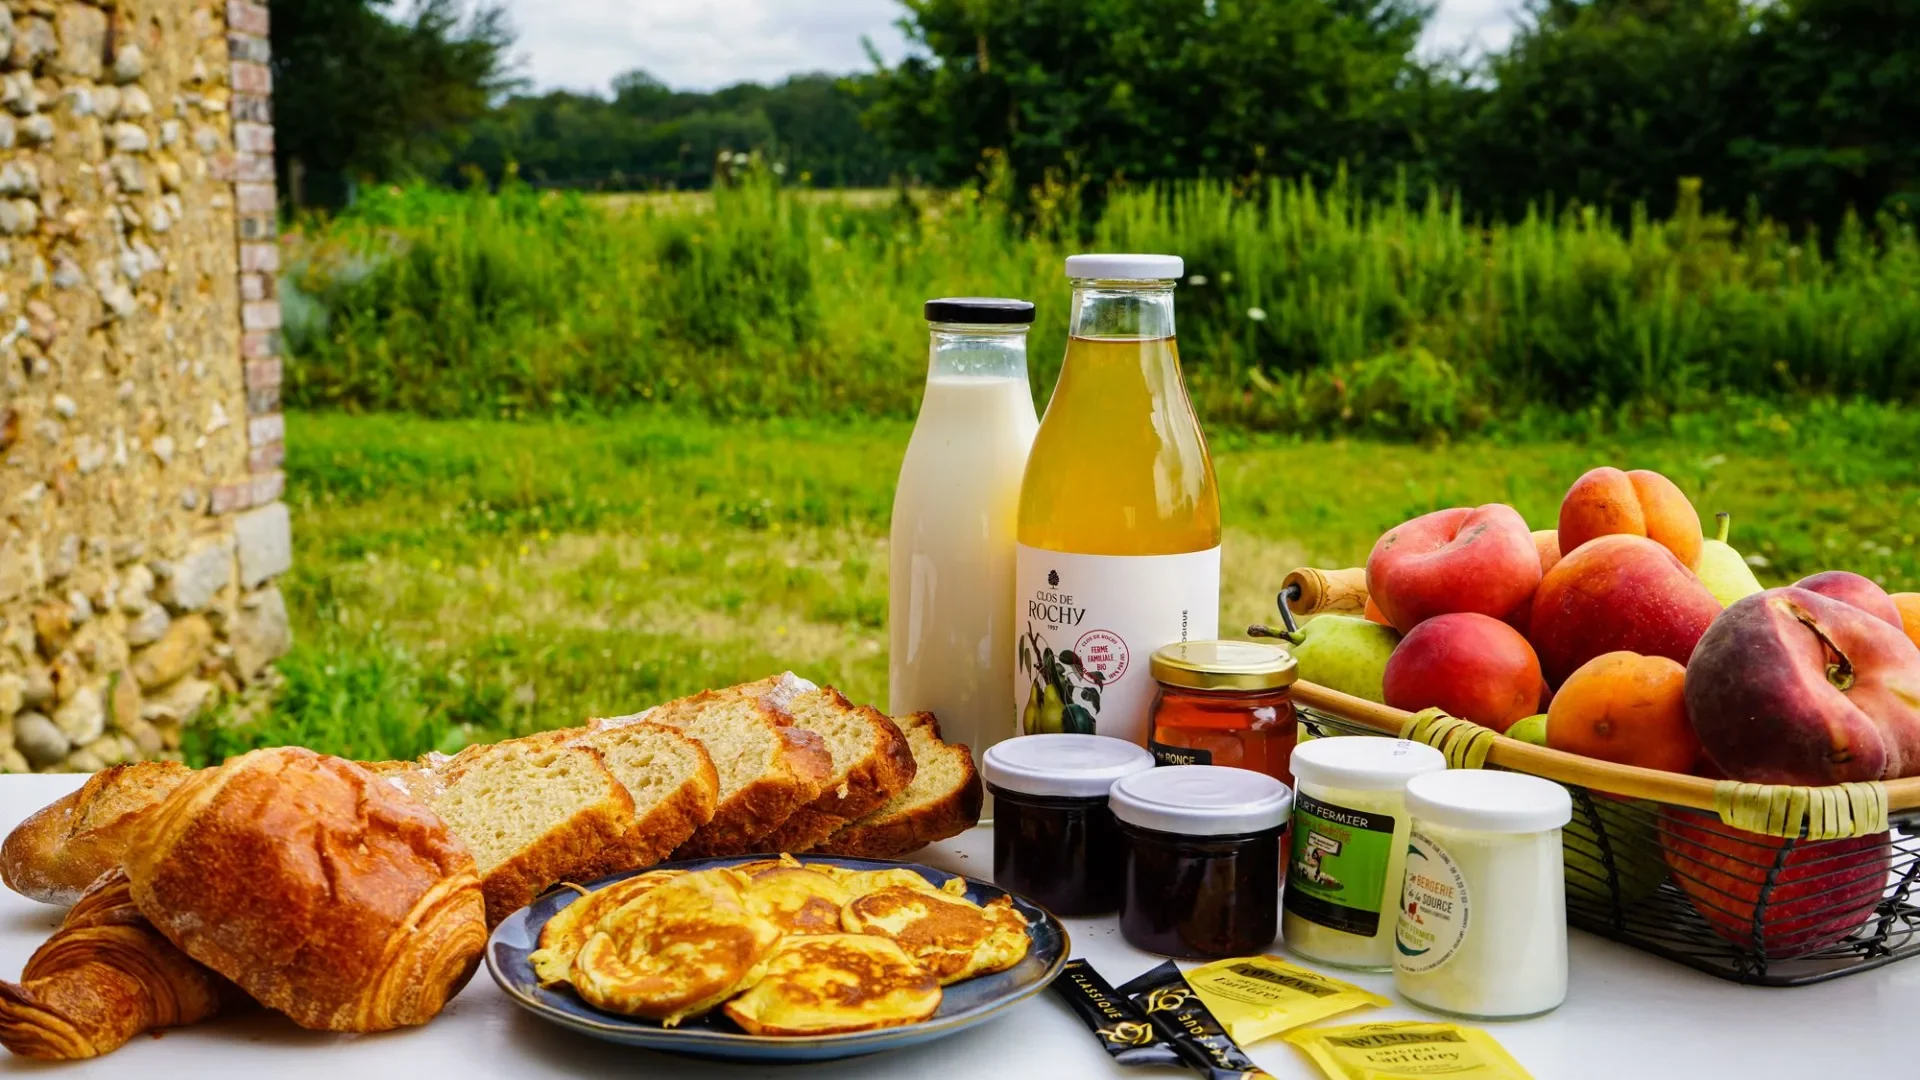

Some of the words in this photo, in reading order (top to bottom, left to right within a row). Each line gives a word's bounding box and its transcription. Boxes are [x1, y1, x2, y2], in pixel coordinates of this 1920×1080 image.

[1036, 590, 1058, 603] CLOS
[1059, 594, 1074, 605] DE
[1028, 600, 1086, 626] ROCHY
[1091, 645, 1109, 654] FERME
[1087, 653, 1114, 663] FAMILIALE
[1096, 663, 1107, 671] BIO
[1297, 797, 1317, 813] OURT
[1316, 805, 1369, 828] FERMIER
[1417, 874, 1455, 899] BERGERIE
[1421, 893, 1454, 914] SOURCE
[1071, 973, 1123, 1020] CLASSIQUE
[1342, 1033, 1454, 1049] TWININGS
[1366, 1053, 1410, 1063] Earl
[1414, 1051, 1460, 1063] Grey
[1375, 1046, 1438, 1056] ORIGINAL
